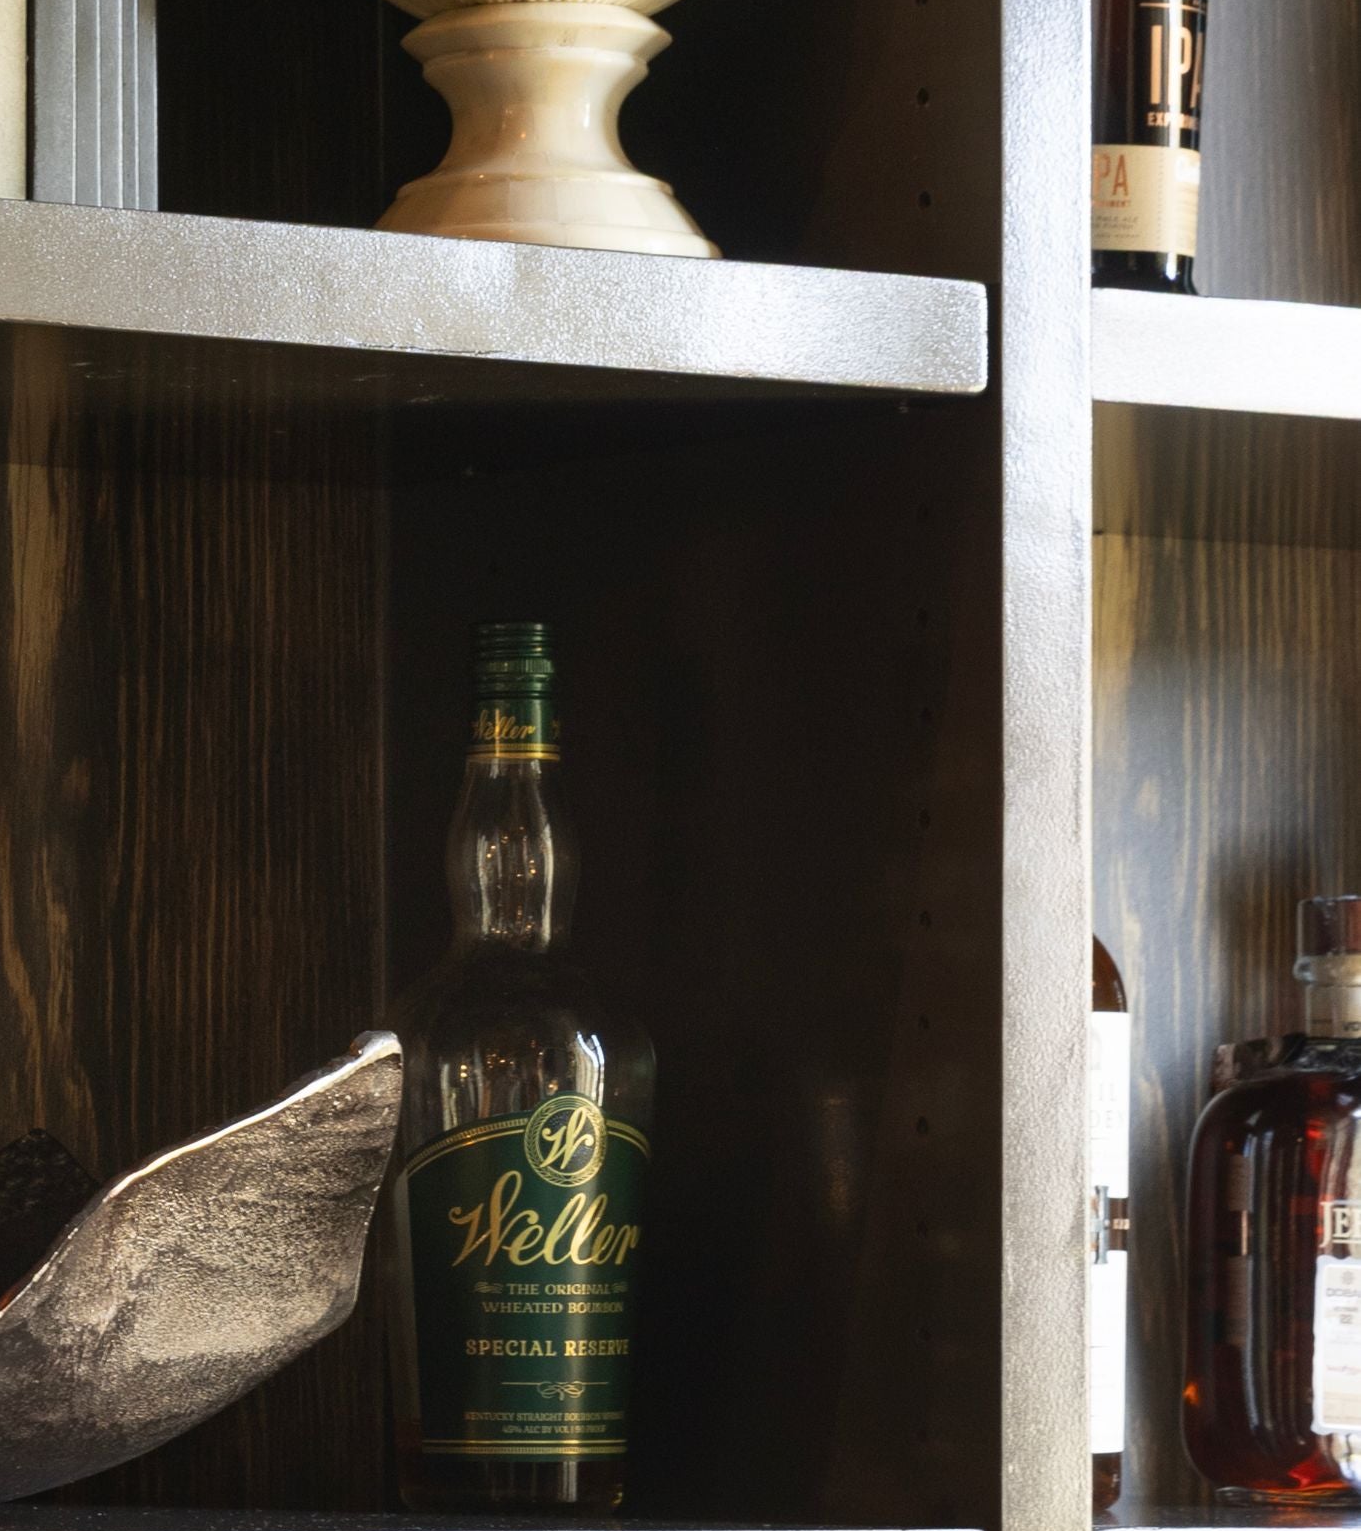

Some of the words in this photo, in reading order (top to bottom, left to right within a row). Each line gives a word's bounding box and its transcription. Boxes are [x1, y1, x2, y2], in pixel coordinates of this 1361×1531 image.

[448, 1169, 640, 1268] Weller
[506, 1283, 540, 1296] THE
[544, 1283, 611, 1296] ORIGINAL
[482, 1301, 564, 1314] WHEATED
[568, 1302, 624, 1314] BOURBON
[465, 1338, 558, 1357] SPECIAL
[563, 1338, 630, 1357] RESERVE
